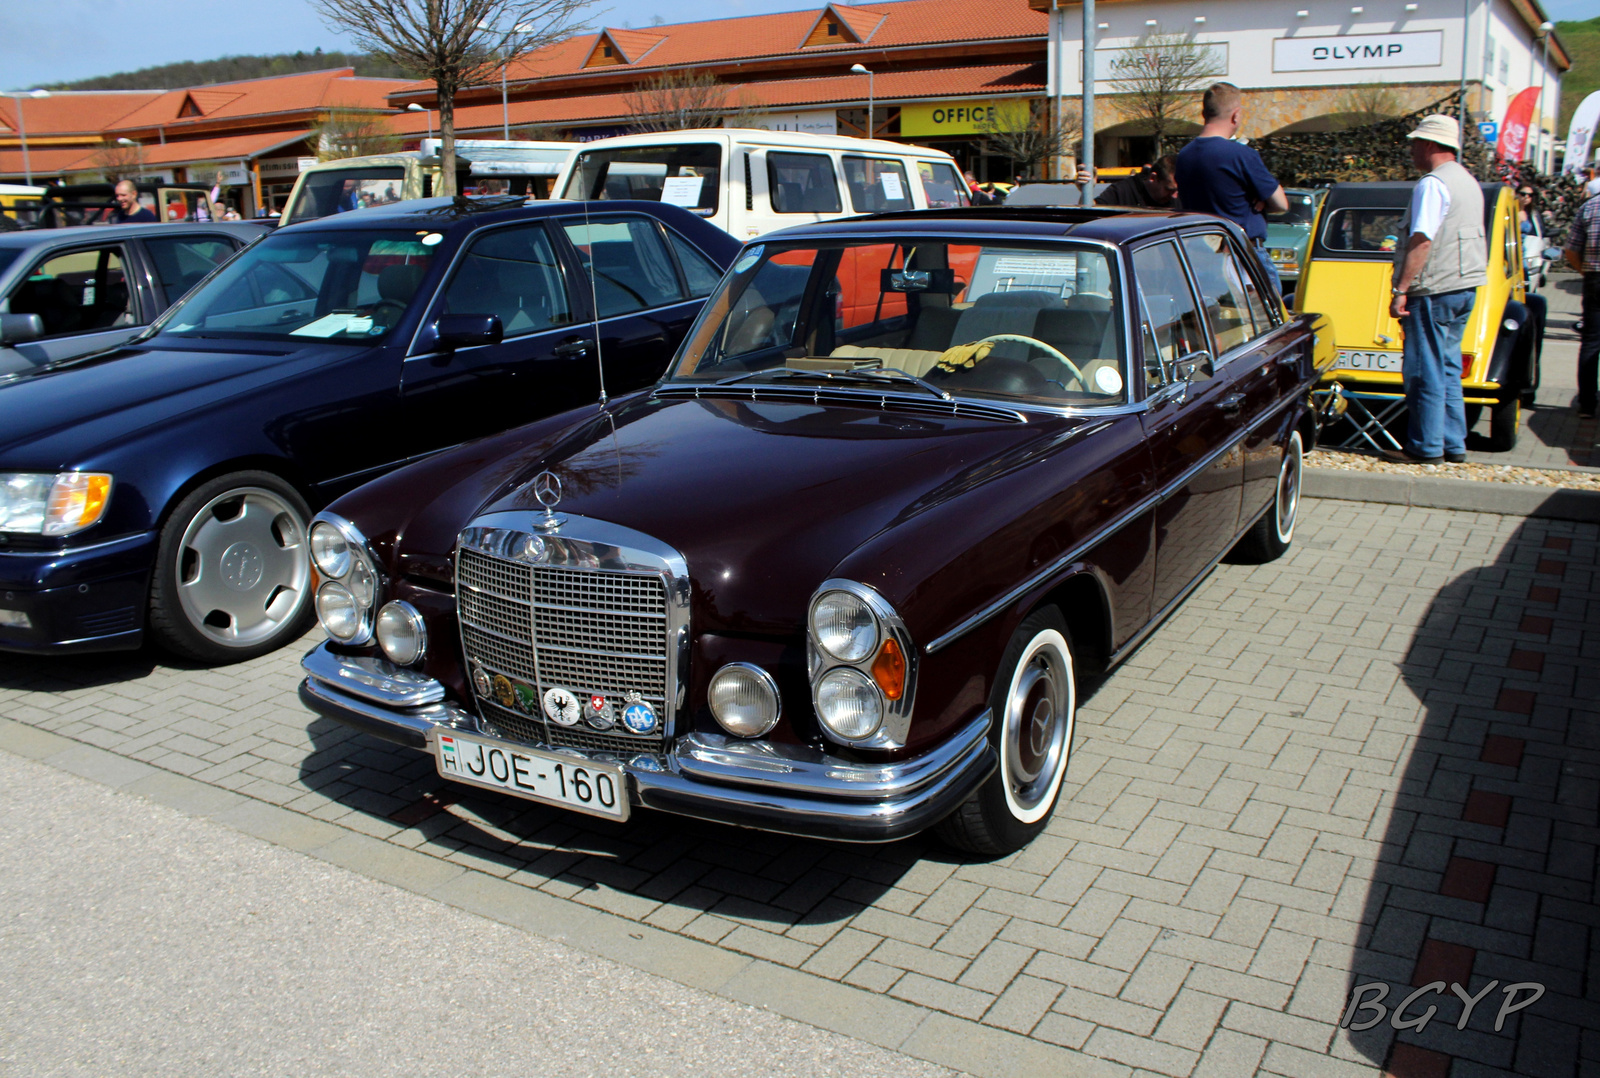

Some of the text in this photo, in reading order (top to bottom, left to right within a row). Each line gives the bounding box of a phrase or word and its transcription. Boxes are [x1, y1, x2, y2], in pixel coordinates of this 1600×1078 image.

[1312, 43, 1403, 60] OLYMP
[932, 106, 994, 124] OFFICE
[1351, 352, 1404, 369] CTC-
[627, 706, 654, 729] RAC
[443, 745, 615, 808] H JOE-160
